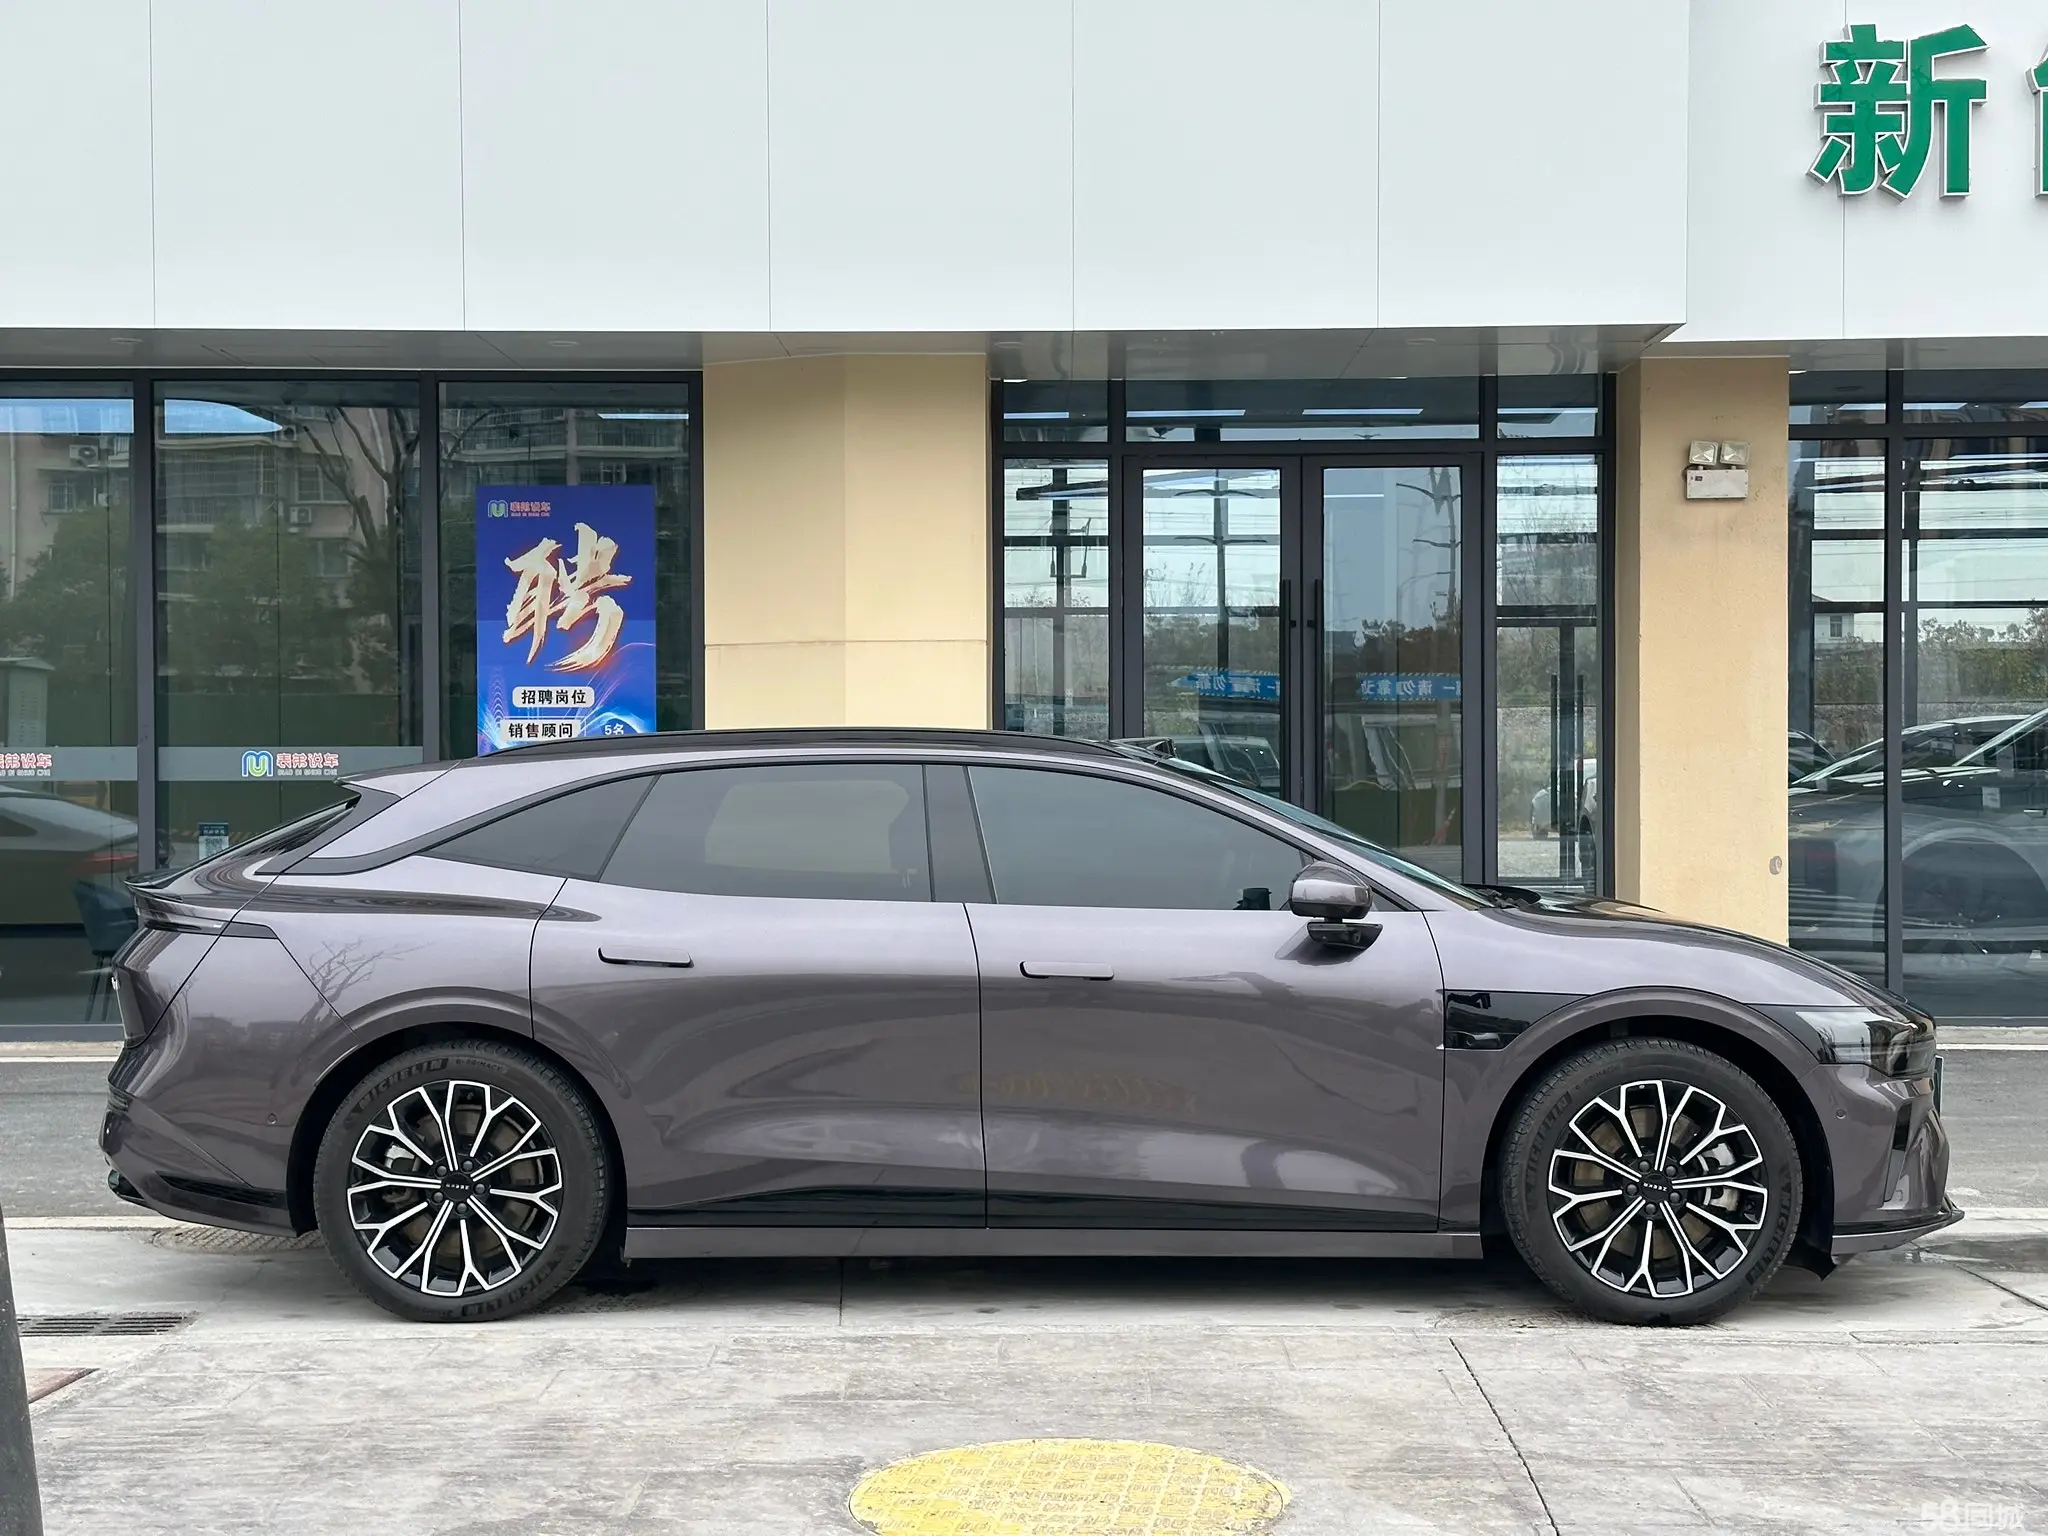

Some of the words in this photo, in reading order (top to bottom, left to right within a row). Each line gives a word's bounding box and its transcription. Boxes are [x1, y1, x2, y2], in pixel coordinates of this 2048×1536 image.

[1806, 22, 2048, 200] 新
[503, 522, 633, 672] 聘
[521, 689, 587, 705] 招聘岗位
[508, 722, 574, 738] 销售顾问
[604, 723, 625, 736] 5名
[0, 753, 52, 768] 弟说车
[276, 753, 339, 768] 表弟说车
